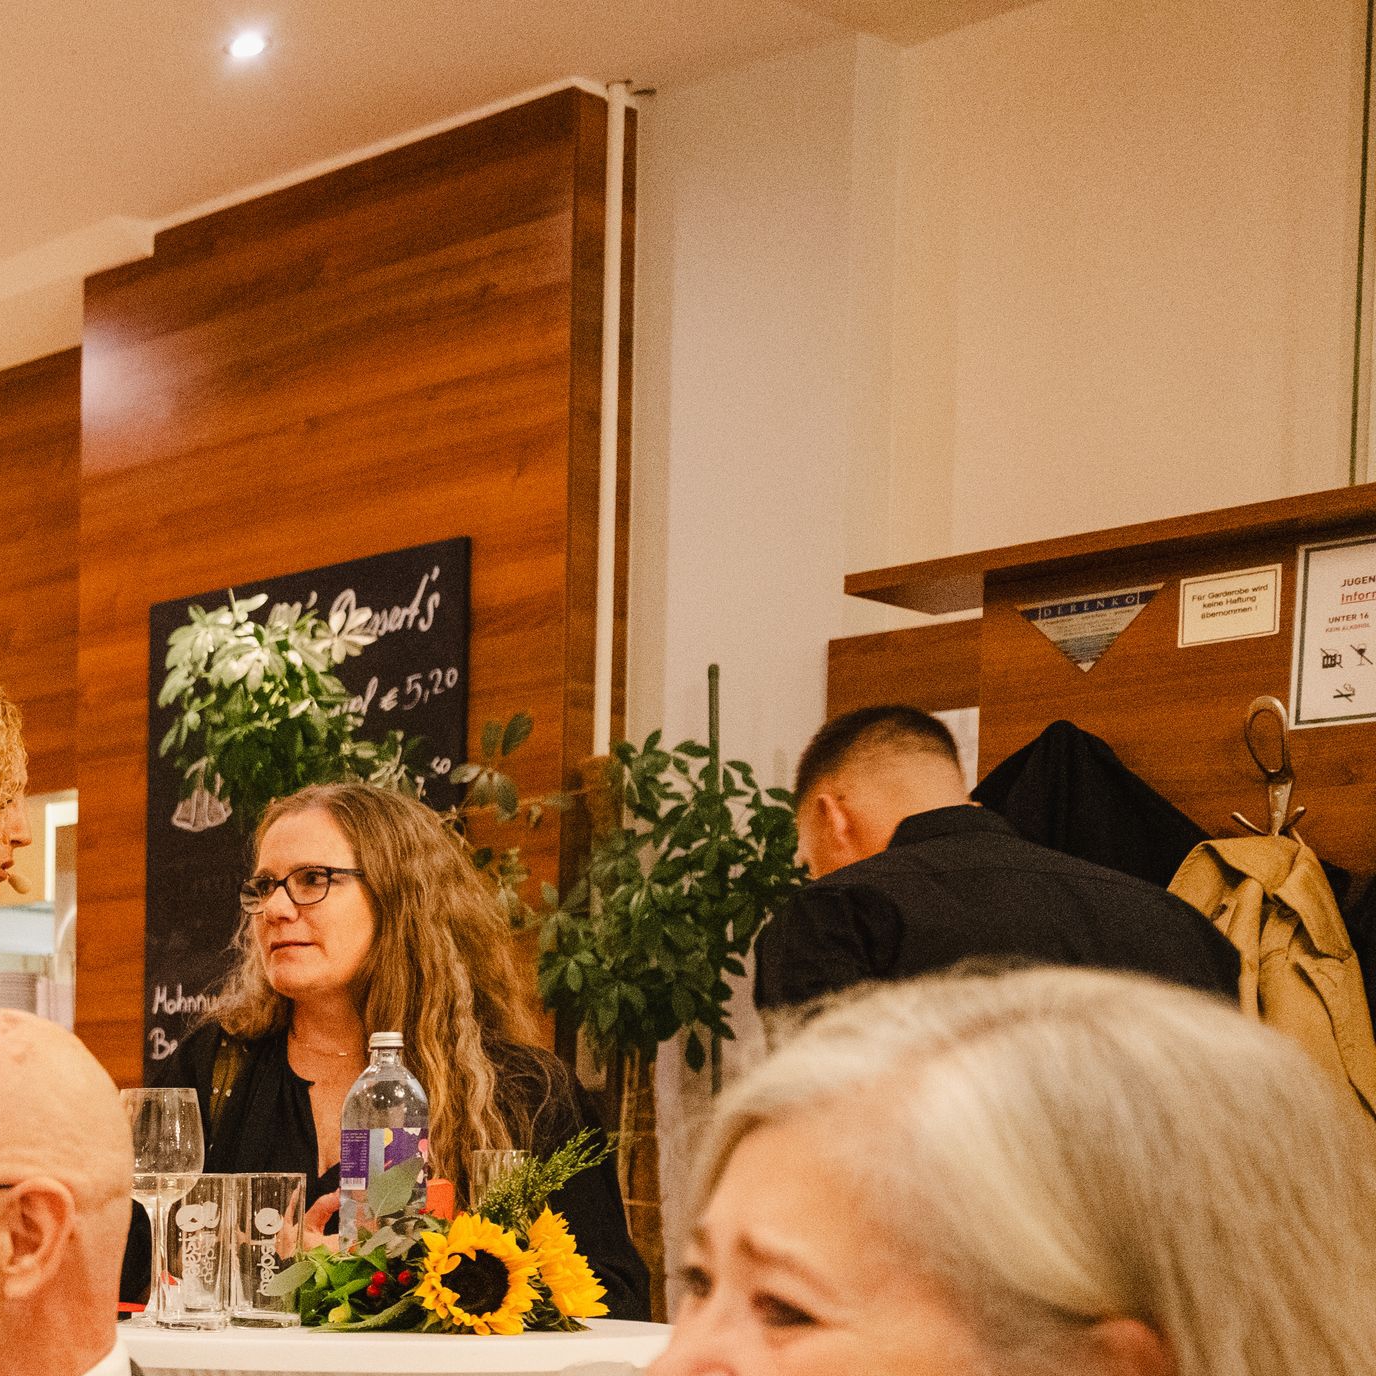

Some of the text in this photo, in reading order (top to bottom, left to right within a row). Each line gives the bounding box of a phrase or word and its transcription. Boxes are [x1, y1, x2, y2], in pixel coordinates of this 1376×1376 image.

[1340, 575, 1376, 588] JUGEN
[1207, 588, 1250, 601] Garderobe
[1251, 583, 1269, 593] wird
[1202, 595, 1257, 609] keine Haftung
[1200, 605, 1252, 619] übernommen
[1328, 612, 1369, 624] UNTER 16
